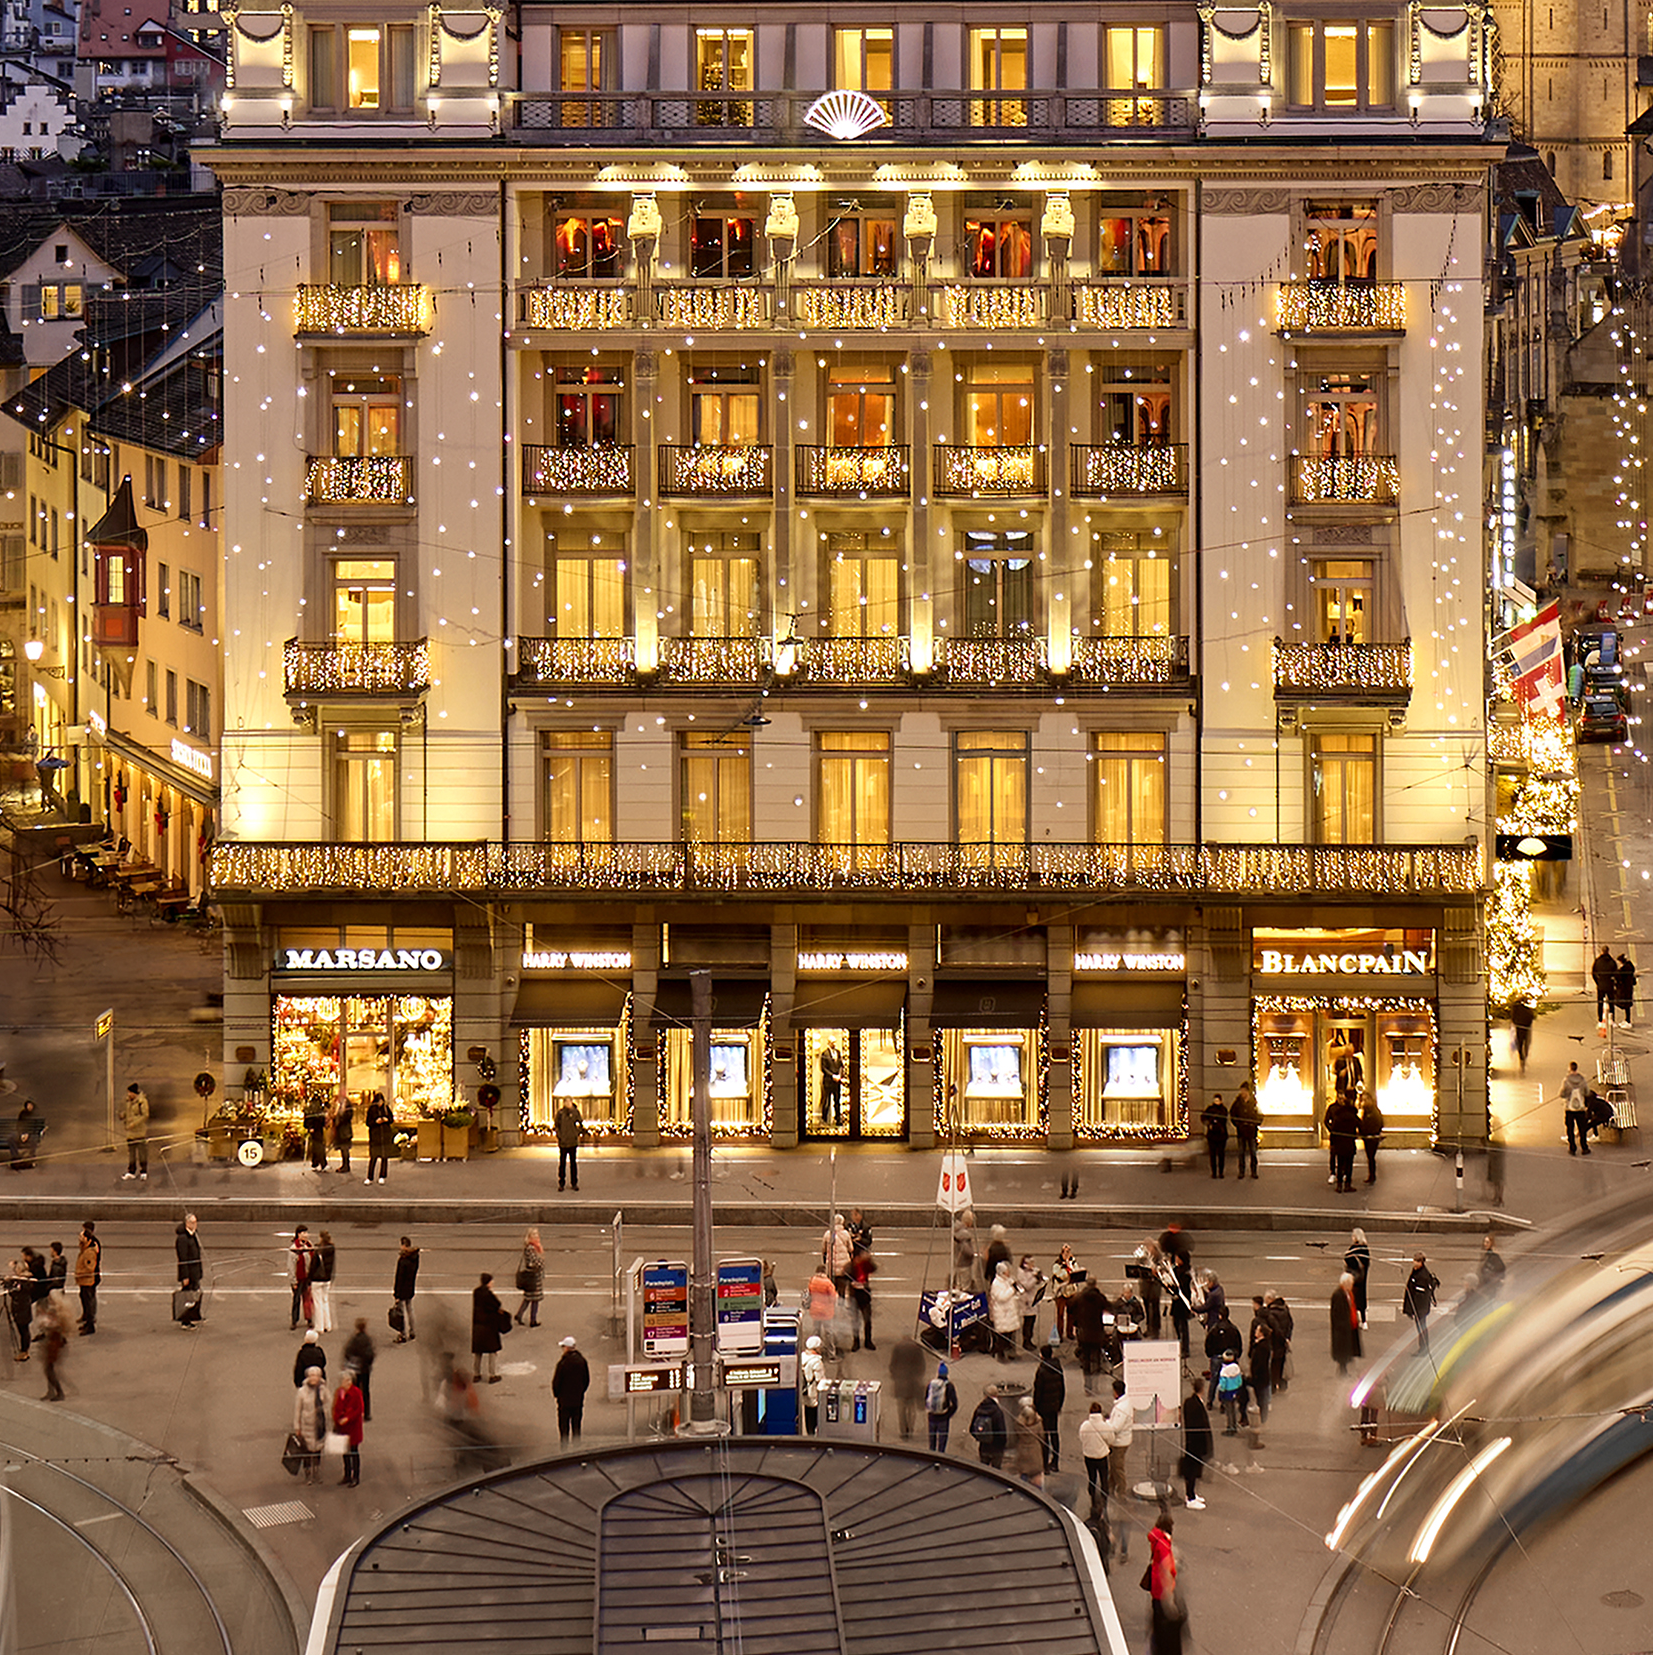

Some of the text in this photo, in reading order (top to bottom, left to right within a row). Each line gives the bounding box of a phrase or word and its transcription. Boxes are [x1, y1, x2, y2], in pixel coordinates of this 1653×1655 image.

[1503, 450, 1517, 588] PHARMACIE
[285, 949, 443, 971] MARSANO
[523, 952, 631, 969] HARRY WINSTON
[798, 953, 907, 970] HARRY WINSTON
[1074, 954, 1185, 971] HARRY WINSTON
[1260, 950, 1428, 975] BLANCPAIN
[243, 1148, 258, 1160] 15
